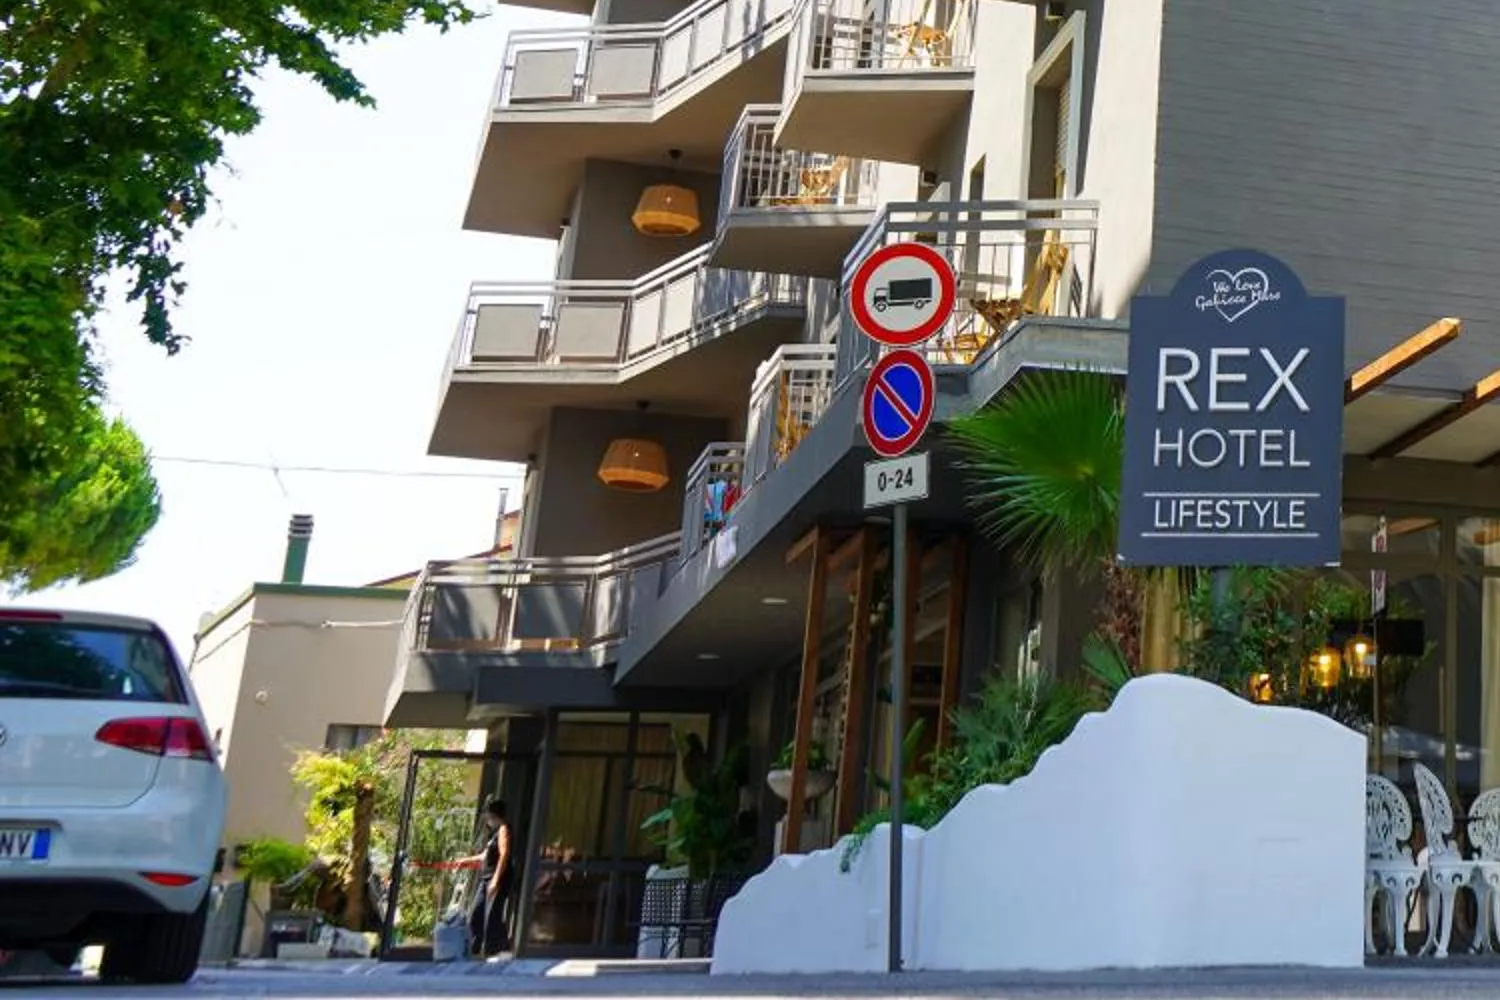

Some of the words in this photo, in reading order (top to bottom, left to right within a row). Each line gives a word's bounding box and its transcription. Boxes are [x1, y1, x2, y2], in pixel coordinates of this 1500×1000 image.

[1157, 347, 1310, 412] REX
[1154, 428, 1311, 468] HOTEL
[877, 467, 913, 492] 0-24
[1154, 500, 1306, 529] LIFESTYLE
